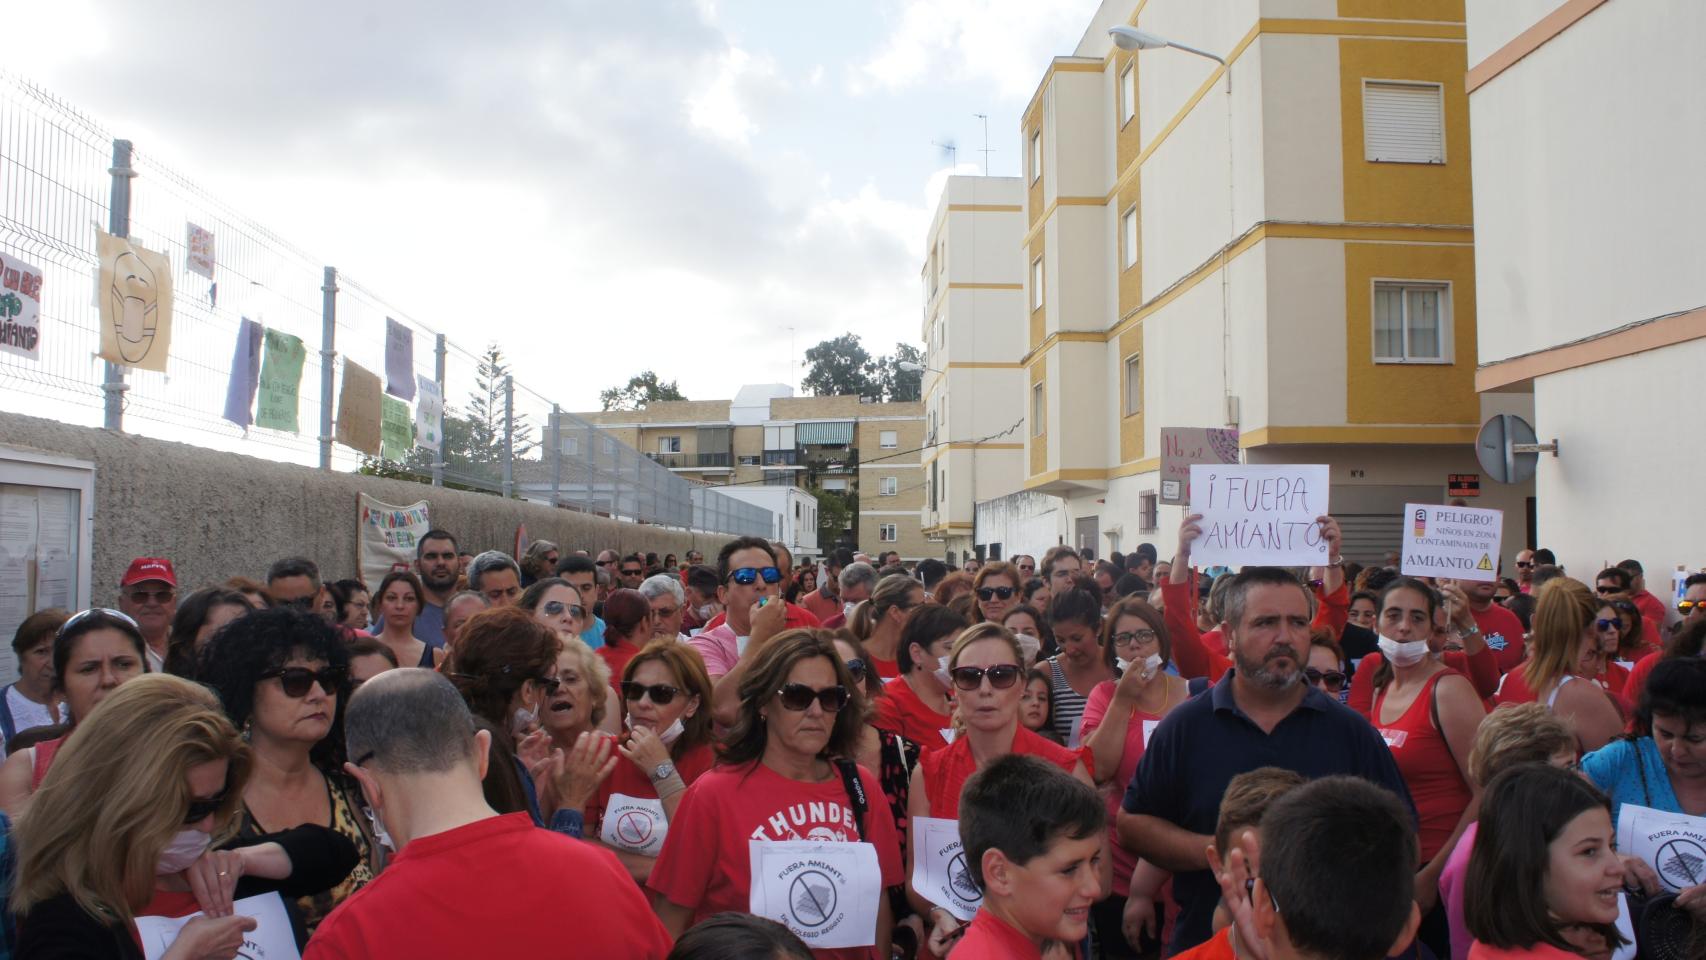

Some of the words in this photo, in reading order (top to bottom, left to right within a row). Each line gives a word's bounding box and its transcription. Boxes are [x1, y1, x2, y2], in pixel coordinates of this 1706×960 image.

[1436, 511, 1494, 526] PELIGRO!
[1436, 527, 1462, 537] NIÑOS
[1463, 529, 1474, 537] EN
[1475, 531, 1497, 539] ZONA
[1415, 537, 1478, 549] CONTAMINADA
[1406, 554, 1474, 569] AMIANTO
[614, 805, 634, 814] FUERA
[751, 801, 859, 841] THUNDE
[1648, 829, 1679, 842] FUERA
[777, 860, 805, 880] FUERA
